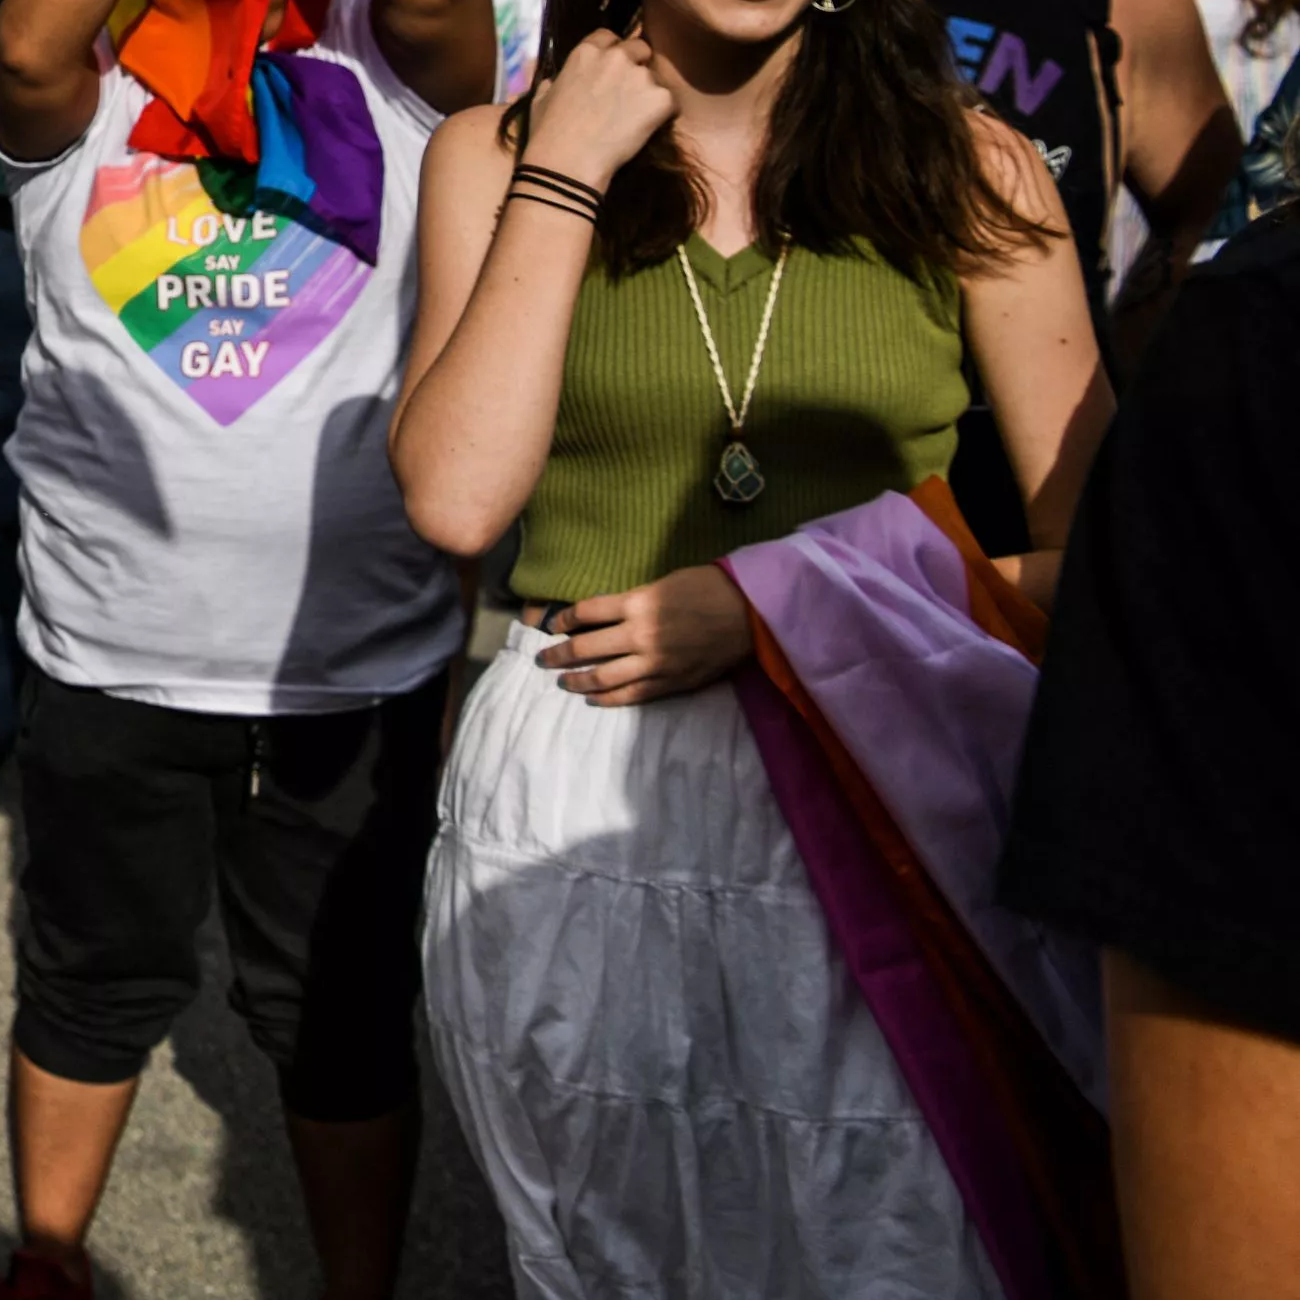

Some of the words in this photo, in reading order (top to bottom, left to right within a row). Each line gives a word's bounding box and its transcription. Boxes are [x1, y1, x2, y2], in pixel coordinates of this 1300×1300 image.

[945, 15, 1064, 117] EN
[166, 210, 278, 247] LOVE
[205, 254, 241, 271] SAY
[156, 269, 291, 311] PRIDE
[208, 319, 245, 337] SAY
[180, 340, 270, 378] GAY
